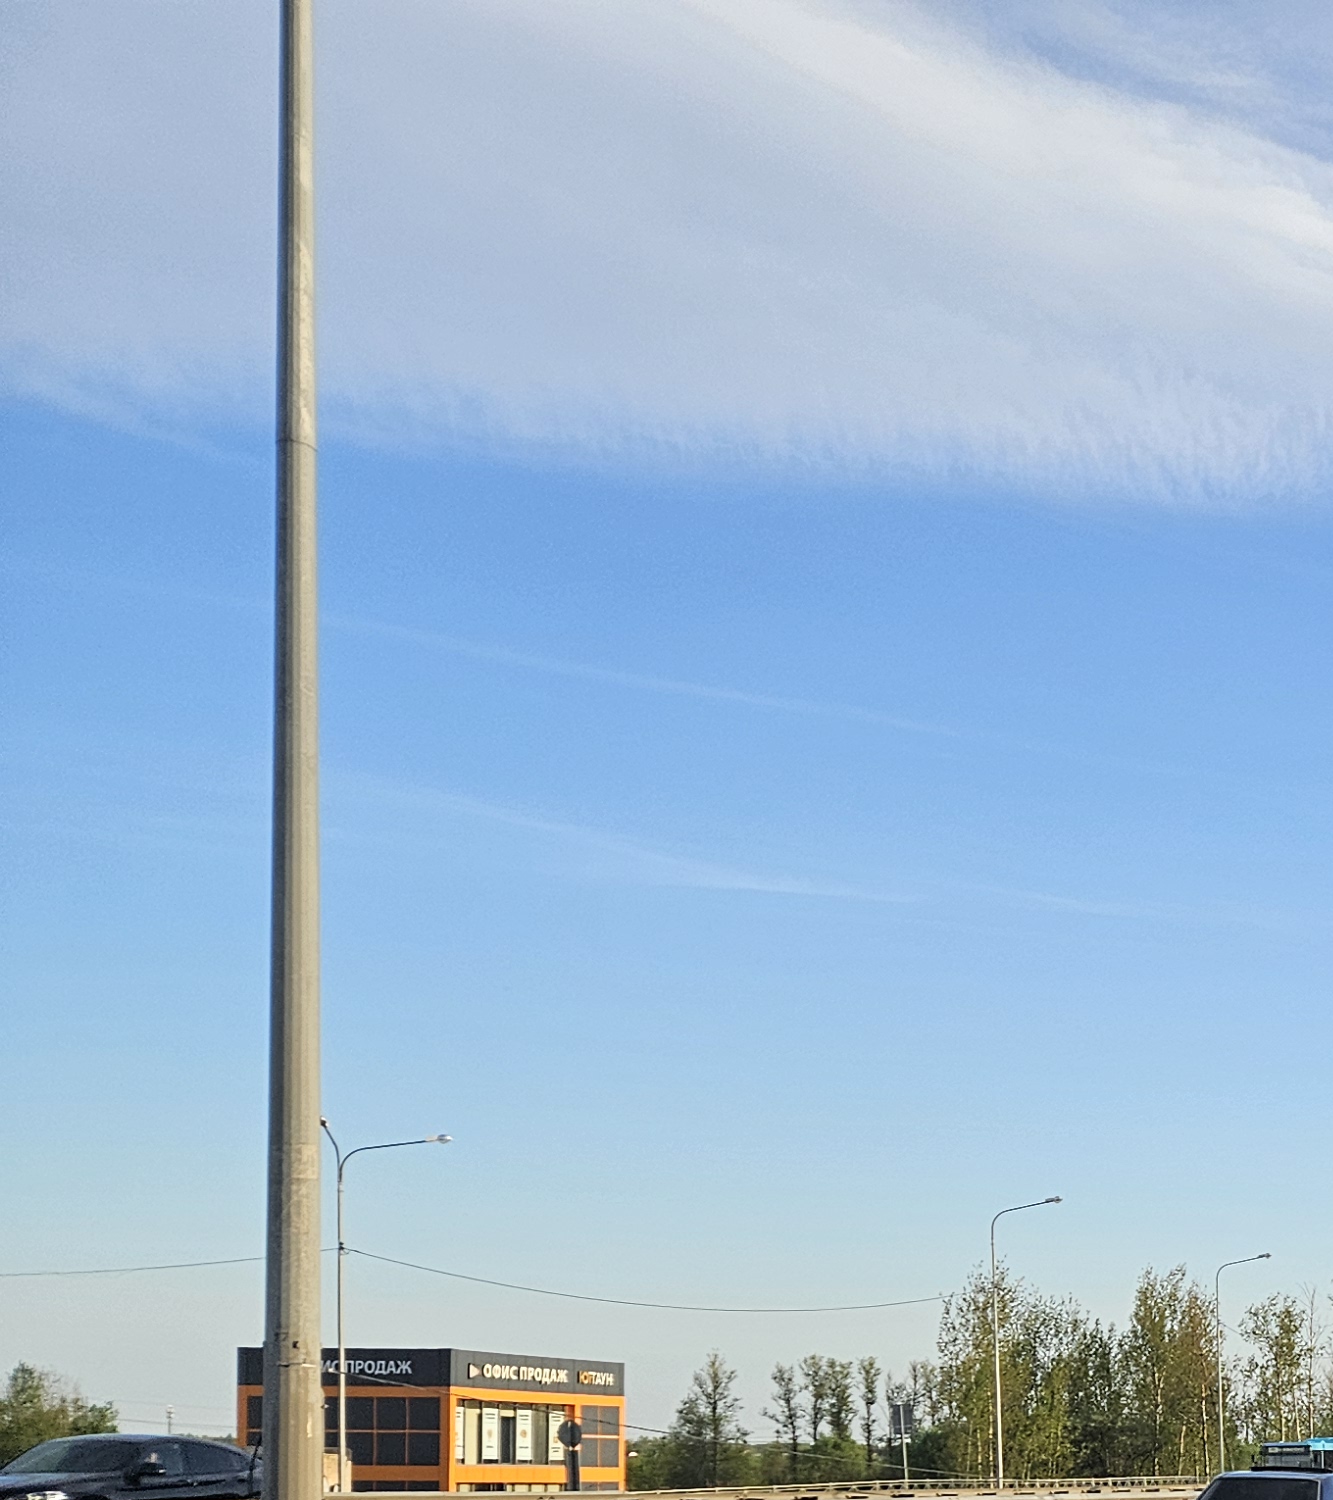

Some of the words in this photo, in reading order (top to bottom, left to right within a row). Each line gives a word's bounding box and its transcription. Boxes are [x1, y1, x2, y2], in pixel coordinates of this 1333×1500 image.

[344, 1359, 412, 1375] ПРОДАЖ
[483, 1363, 518, 1380] ОФИС
[519, 1366, 568, 1384] ПРОДАЖ
